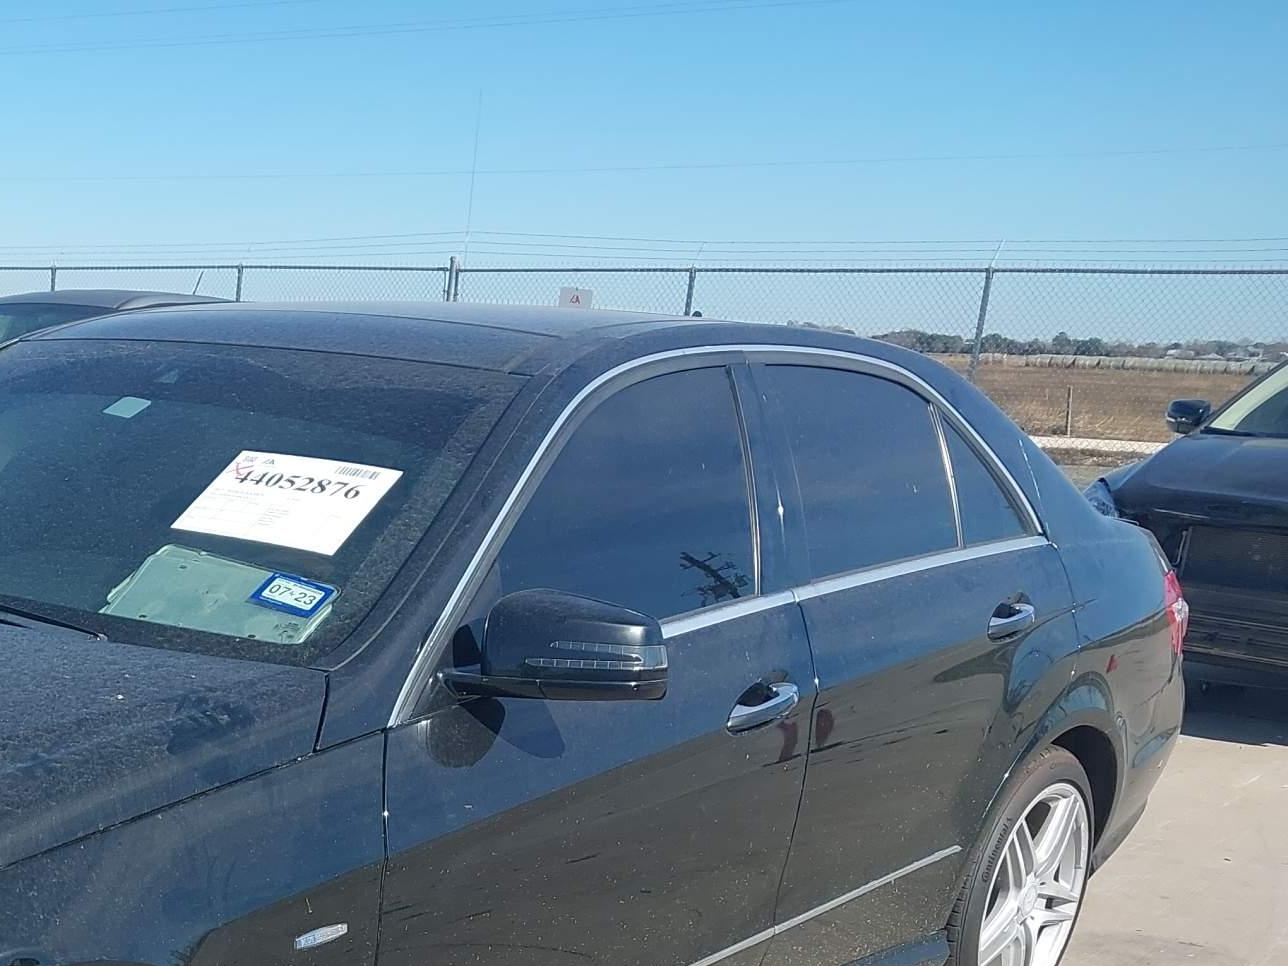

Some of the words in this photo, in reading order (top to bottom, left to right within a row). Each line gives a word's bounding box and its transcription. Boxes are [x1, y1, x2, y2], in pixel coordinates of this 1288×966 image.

[234, 469, 368, 500] 44052876
[268, 584, 290, 596] 07
[294, 592, 317, 605] 23
[982, 823, 1009, 883] Continental
